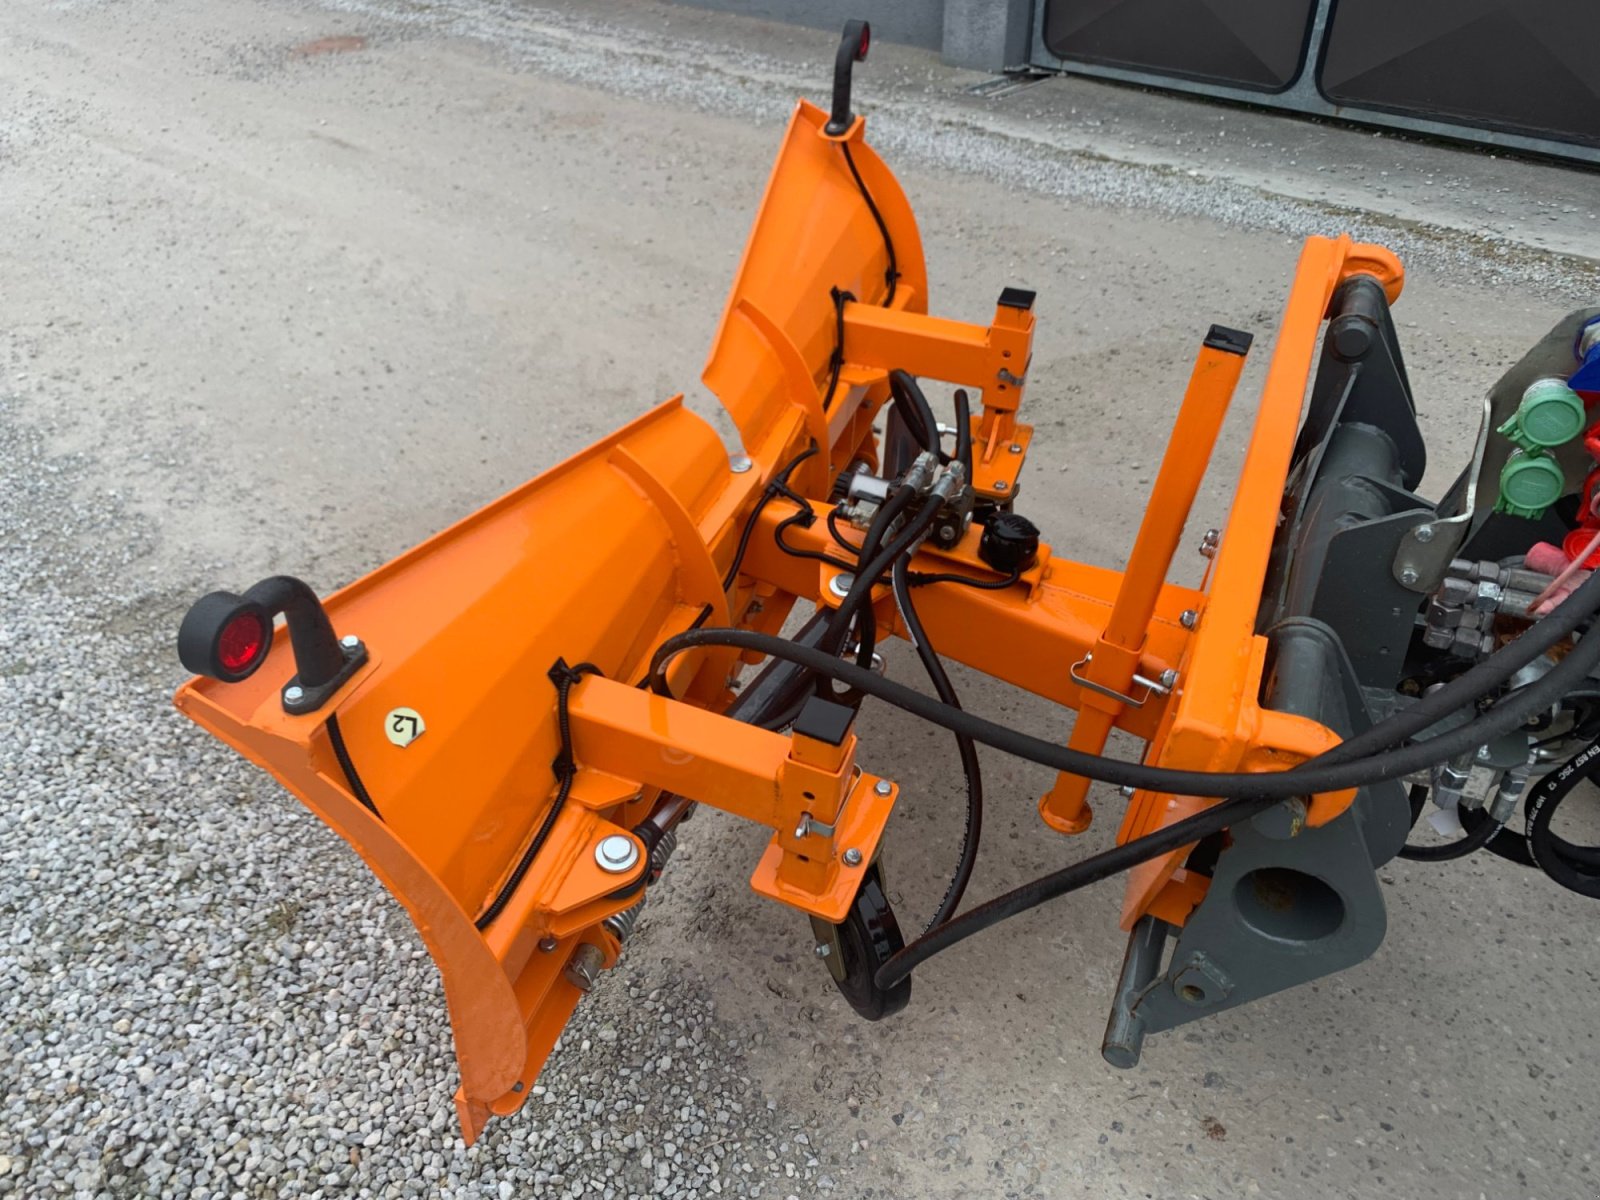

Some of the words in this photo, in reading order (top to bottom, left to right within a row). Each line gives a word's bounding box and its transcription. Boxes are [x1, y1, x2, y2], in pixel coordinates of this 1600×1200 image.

[393, 713, 417, 738] L2
[1587, 745, 1600, 757] EN
[1575, 754, 1589, 767] 857
[1558, 765, 1574, 780] 2SC
